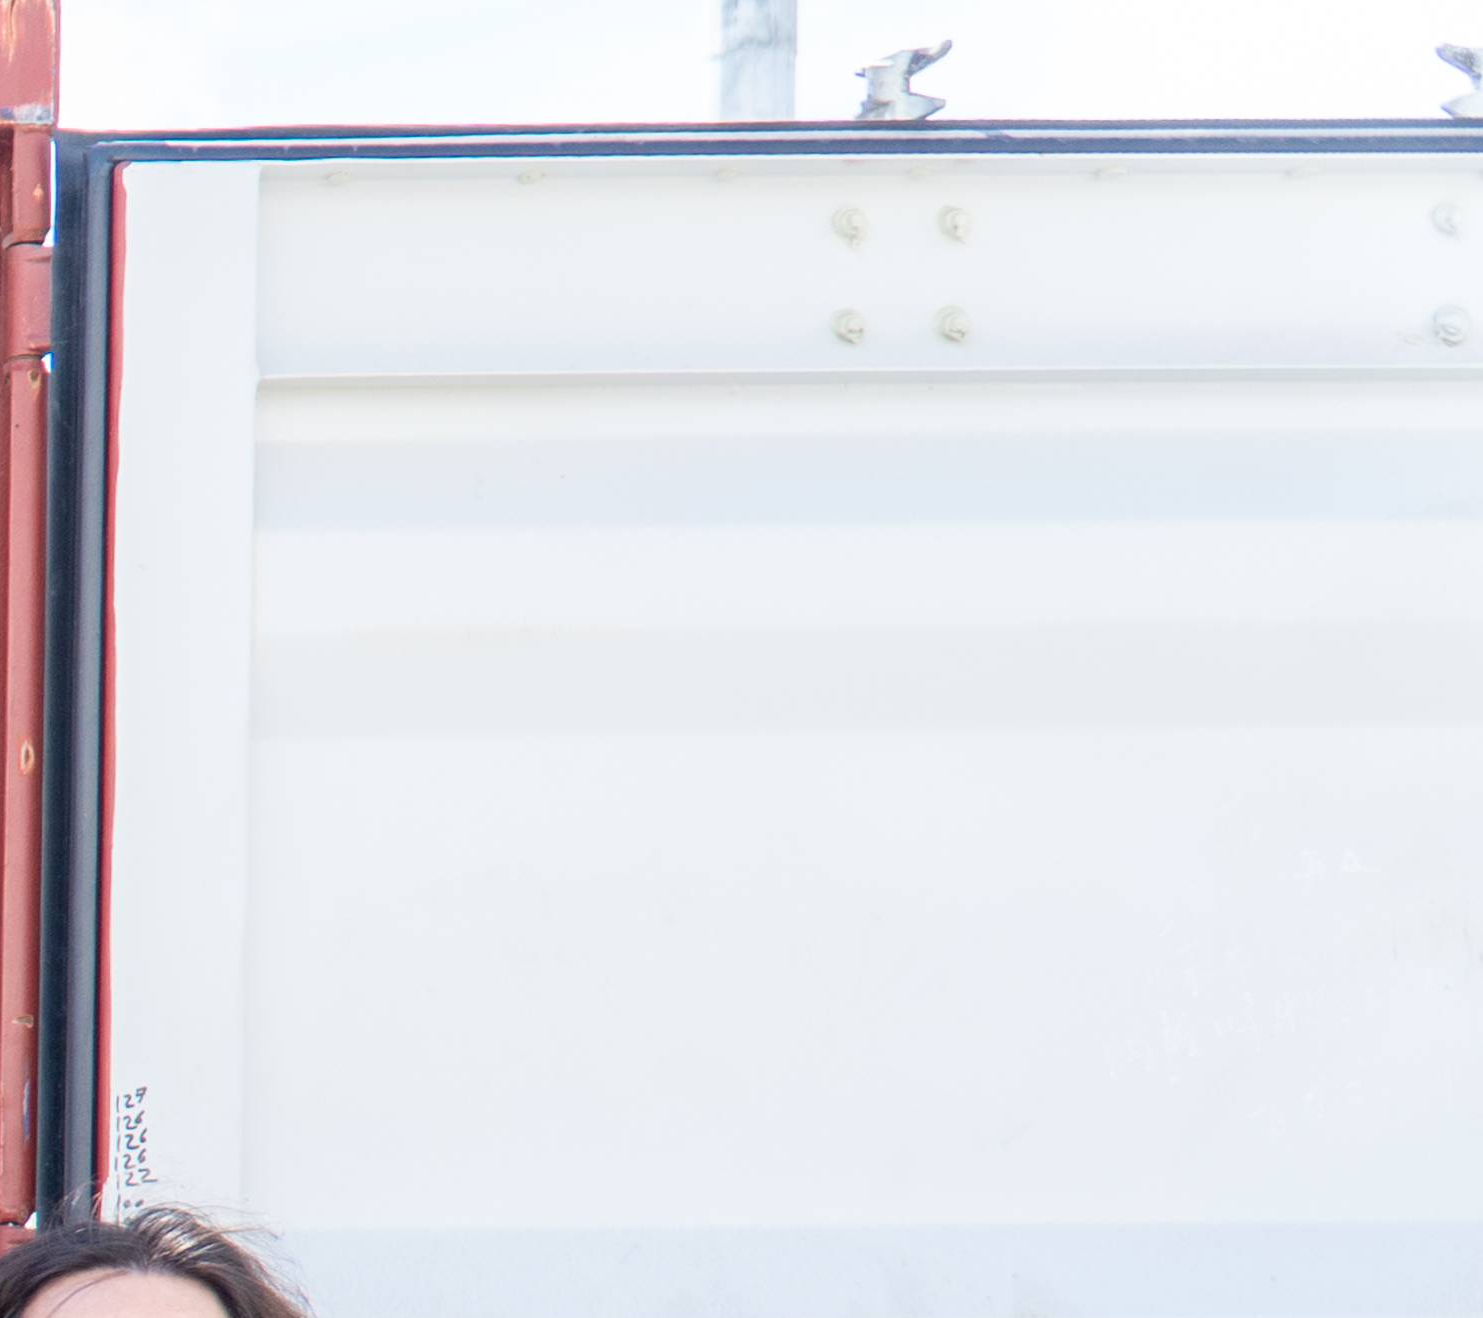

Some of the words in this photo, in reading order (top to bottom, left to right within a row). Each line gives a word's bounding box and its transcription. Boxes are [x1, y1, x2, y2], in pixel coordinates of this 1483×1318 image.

[116, 1110, 145, 1132] 126
[116, 1128, 148, 1152] 126
[114, 1148, 147, 1171] 126
[115, 1168, 159, 1190] 122
